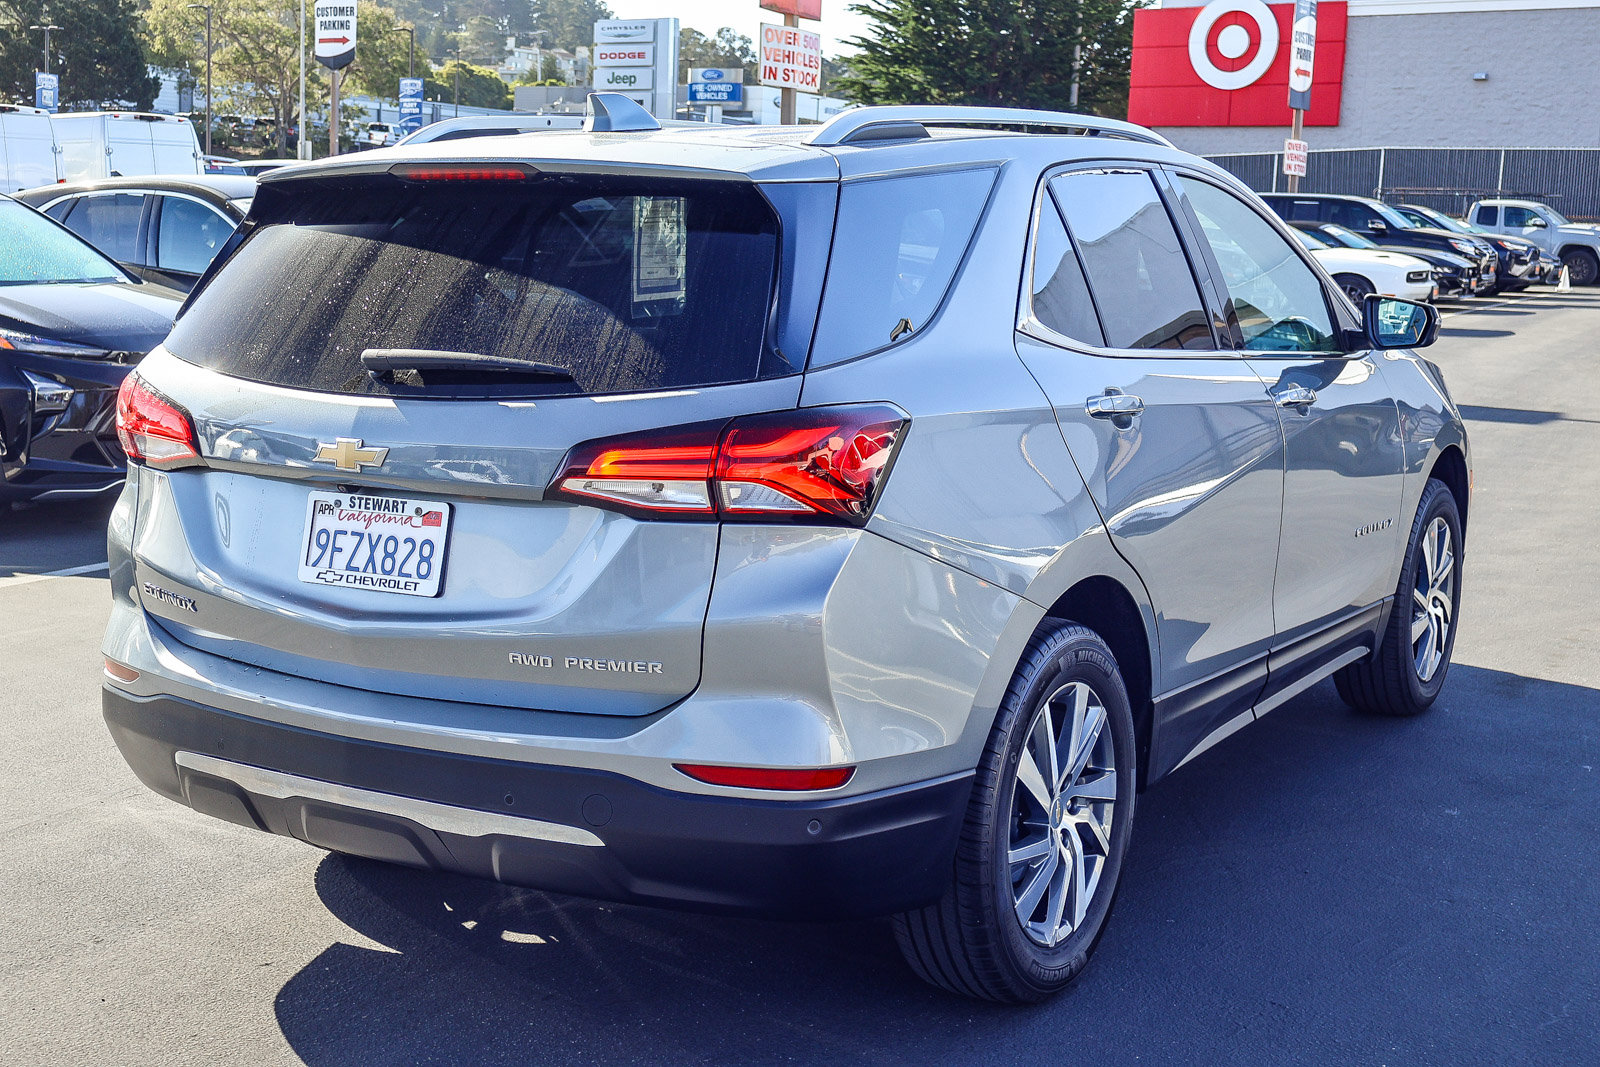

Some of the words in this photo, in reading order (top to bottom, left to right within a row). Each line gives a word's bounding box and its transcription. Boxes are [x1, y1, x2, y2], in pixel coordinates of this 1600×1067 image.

[316, 6, 355, 17] CUSTOMER
[319, 19, 351, 31] PARKING
[764, 27, 801, 47] OVER
[803, 34, 819, 51] 500
[600, 52, 646, 60] DODGE
[763, 46, 820, 70] VEHICLES
[607, 72, 637, 87] Jeep
[763, 65, 778, 81] IN
[782, 68, 818, 88] STOCK
[692, 84, 733, 92] PRE-OWNED
[695, 92, 728, 100] VEHICLES
[318, 503, 335, 516] APR
[348, 496, 408, 514] STEWART
[338, 509, 422, 530] California
[311, 528, 435, 580] 9FZX828
[345, 574, 420, 592] CHEVROLET
[508, 652, 553, 668] AWD
[564, 656, 664, 674] PREMIER
[1077, 651, 1114, 677] MICHELIN
